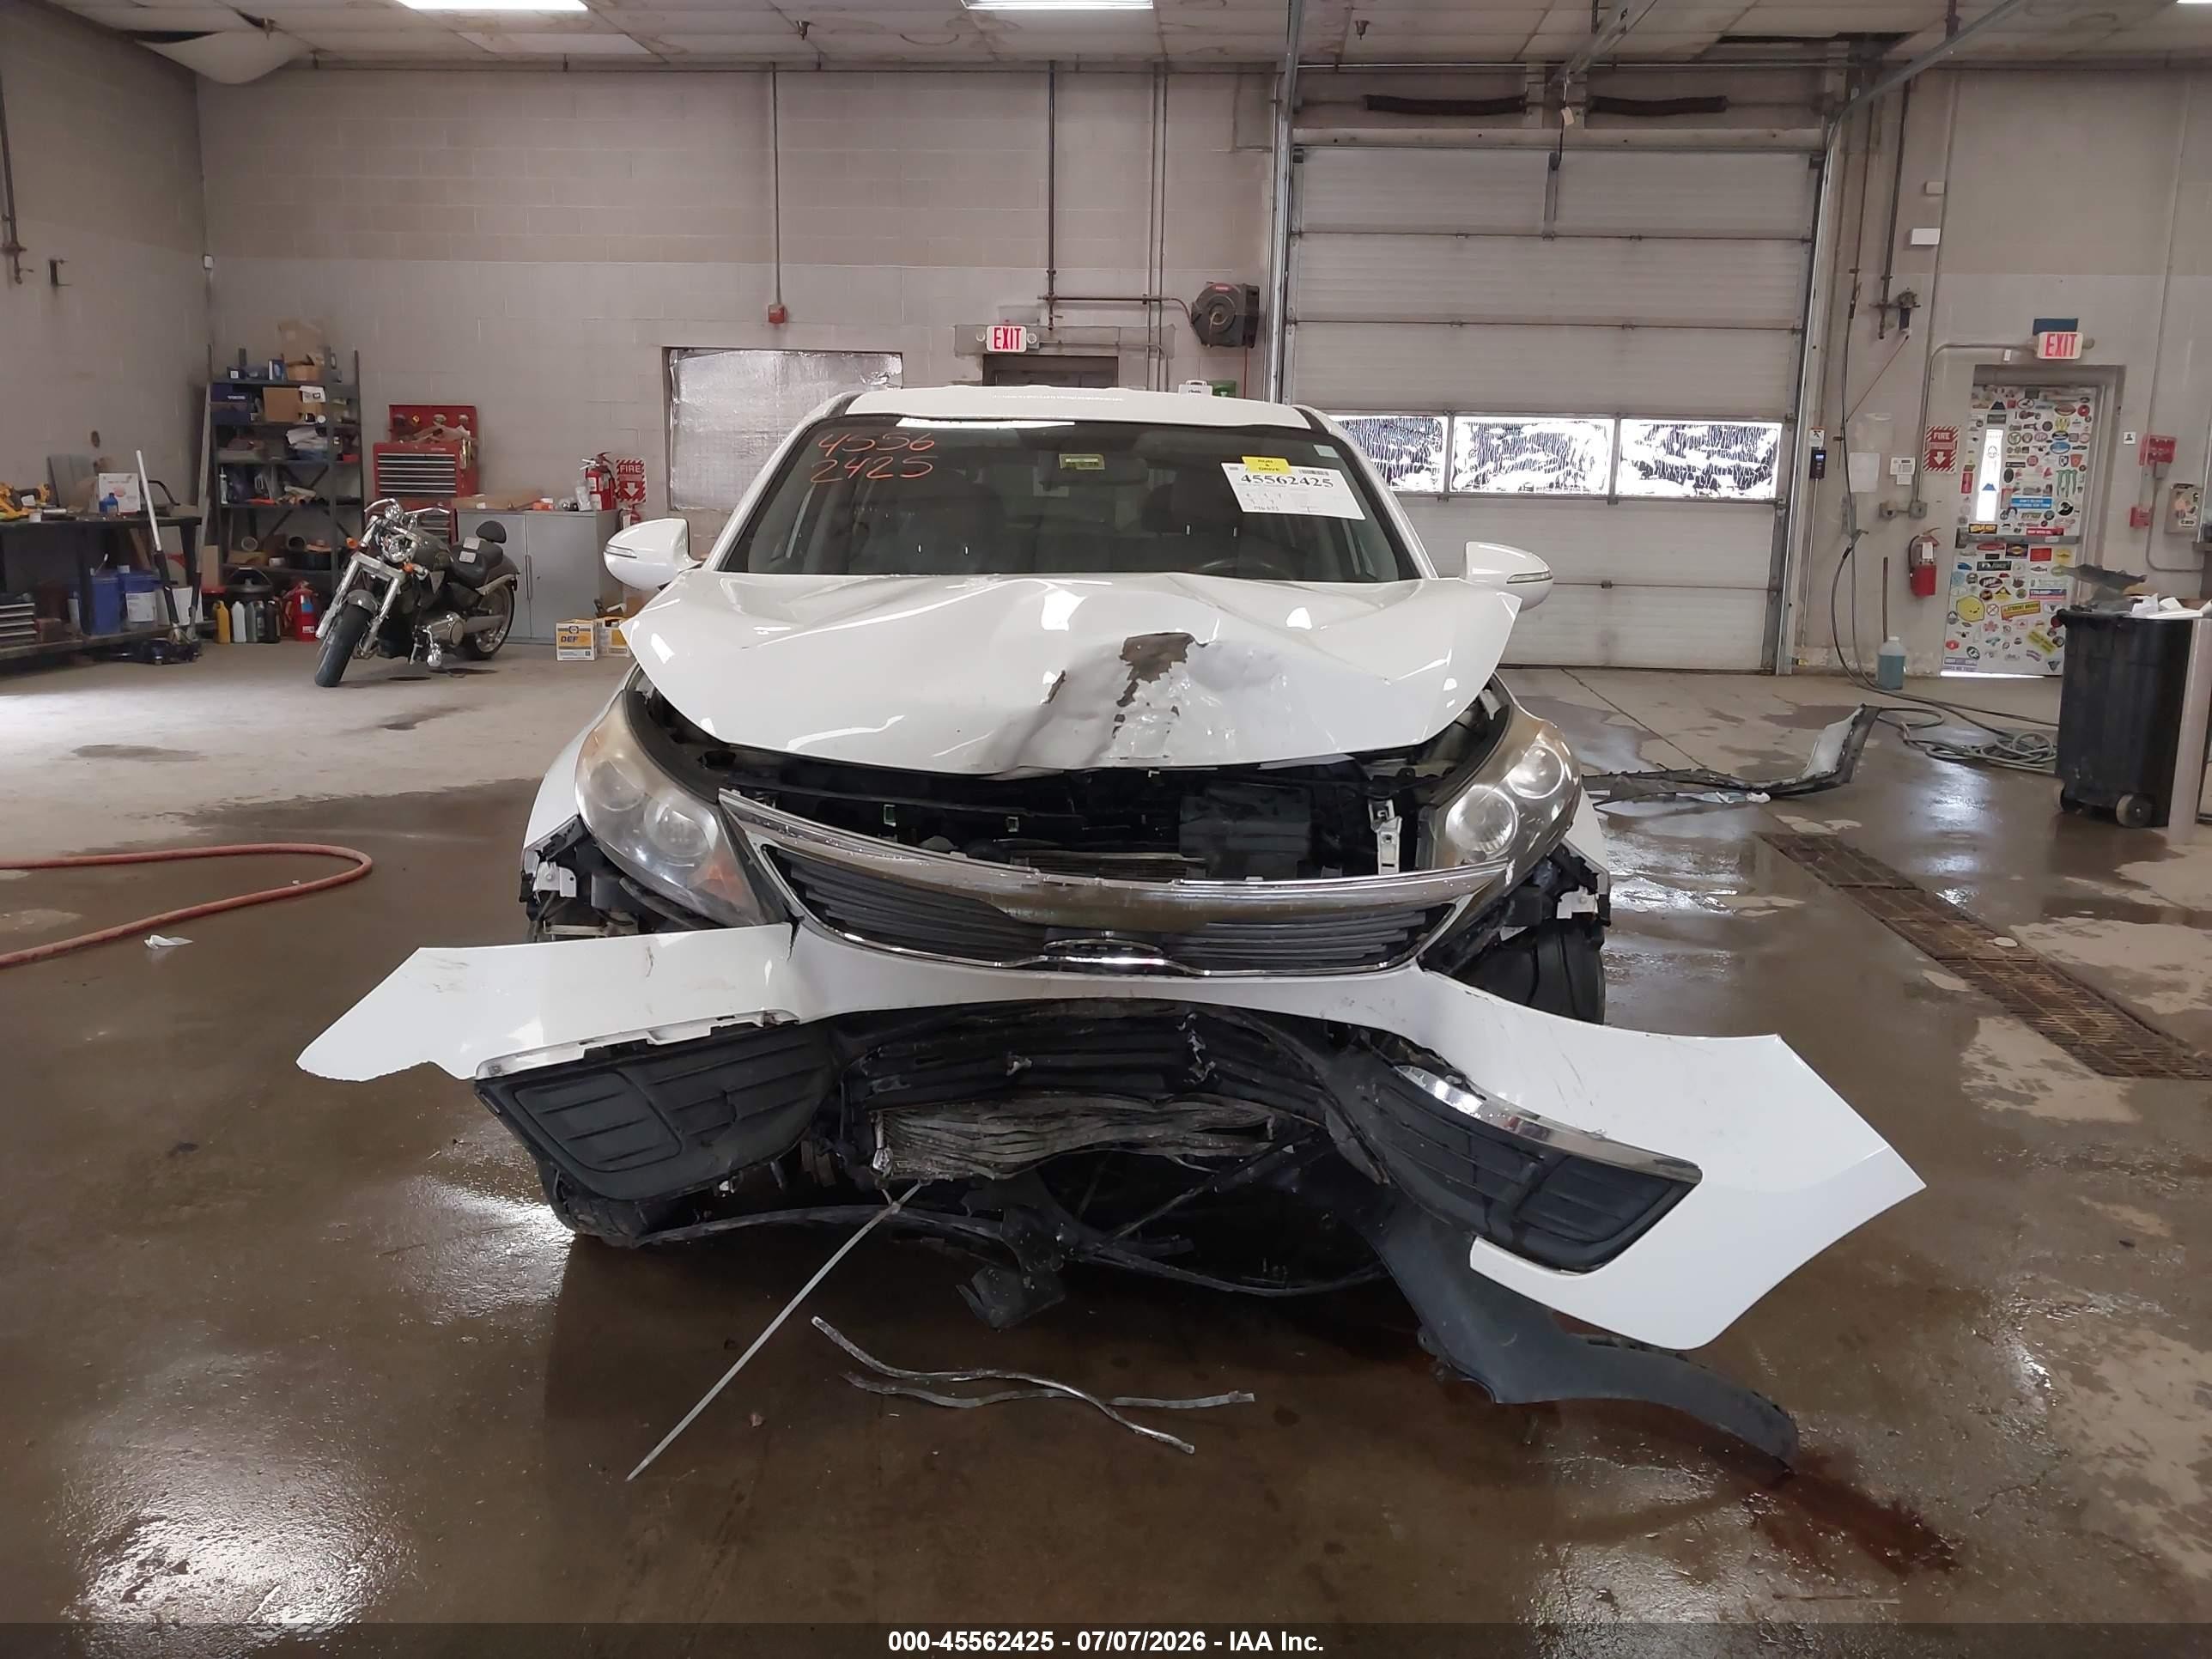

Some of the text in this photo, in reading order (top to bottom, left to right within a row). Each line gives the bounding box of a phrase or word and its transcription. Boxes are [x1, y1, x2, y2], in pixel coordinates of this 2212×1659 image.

[994, 327, 1022, 350] EXIT
[2045, 333, 2077, 357] EXIT
[818, 432, 935, 458] 4556
[619, 465, 641, 473] FIRE
[811, 455, 939, 483] 2425
[1241, 473, 1334, 488] 45562425
